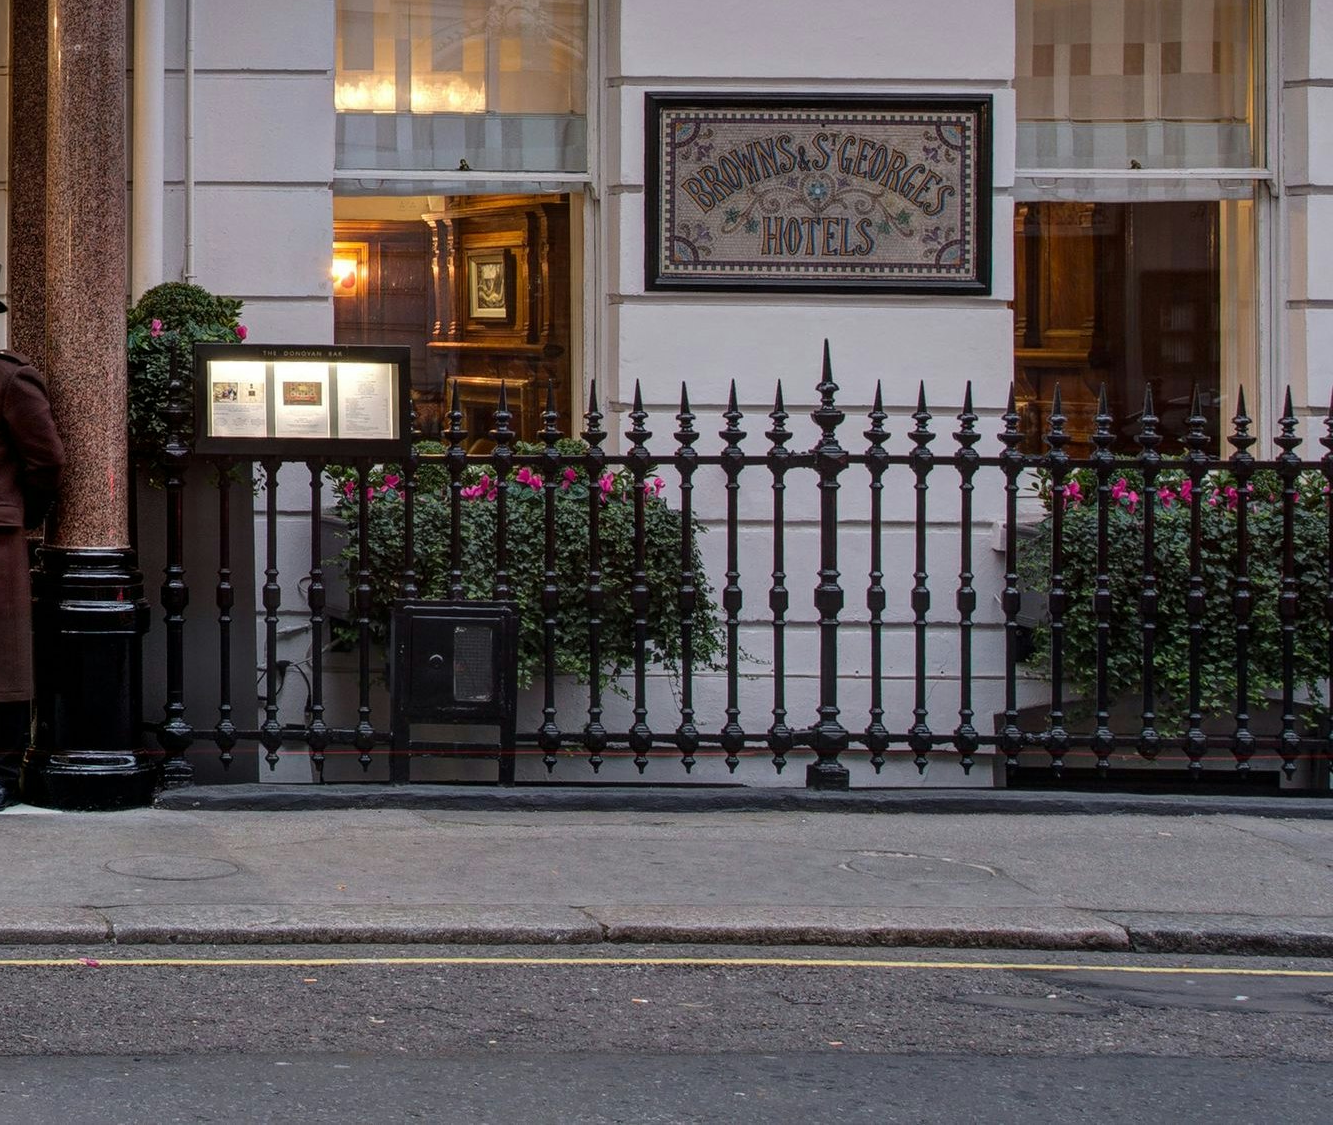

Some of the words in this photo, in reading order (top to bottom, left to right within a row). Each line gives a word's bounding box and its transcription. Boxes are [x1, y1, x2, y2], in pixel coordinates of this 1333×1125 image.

[681, 134, 798, 214] BROWNS
[797, 145, 812, 172] &
[836, 135, 956, 217] GEORGES
[760, 216, 876, 257] HOTELS
